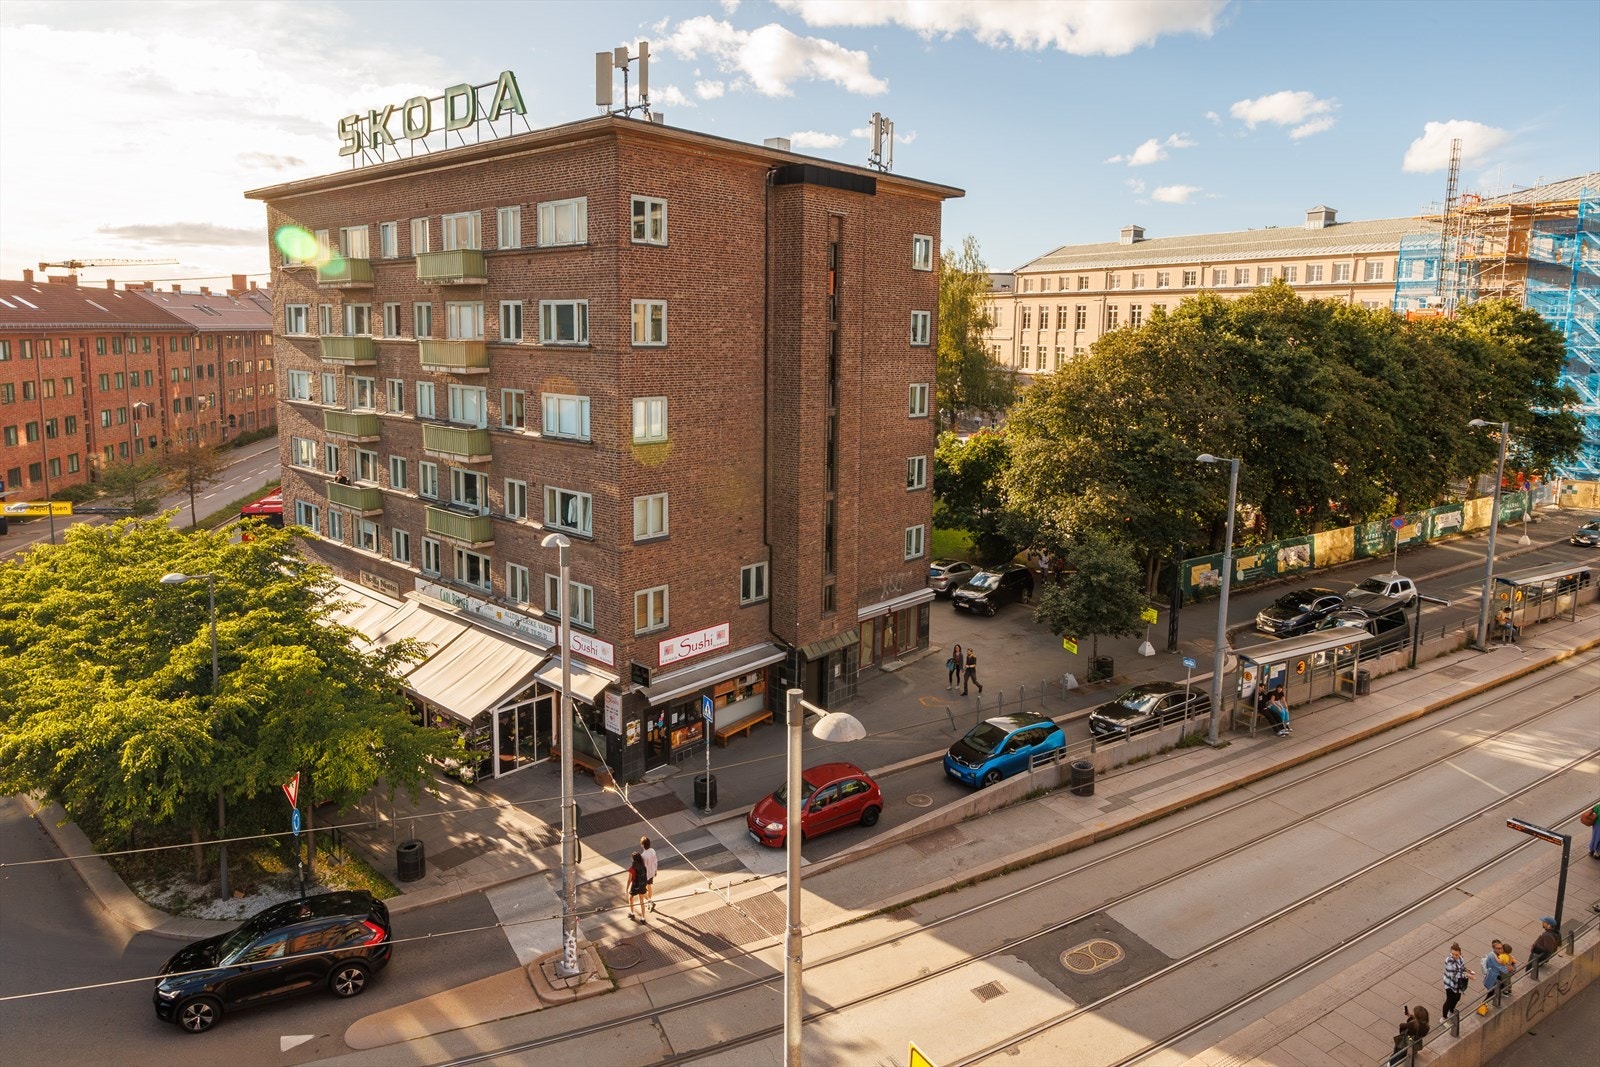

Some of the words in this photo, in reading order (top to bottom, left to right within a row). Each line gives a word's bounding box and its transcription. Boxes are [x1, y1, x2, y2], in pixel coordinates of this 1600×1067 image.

[338, 70, 527, 156] SKODA
[572, 635, 598, 655] Sushi
[678, 633, 713, 657] Sushi
